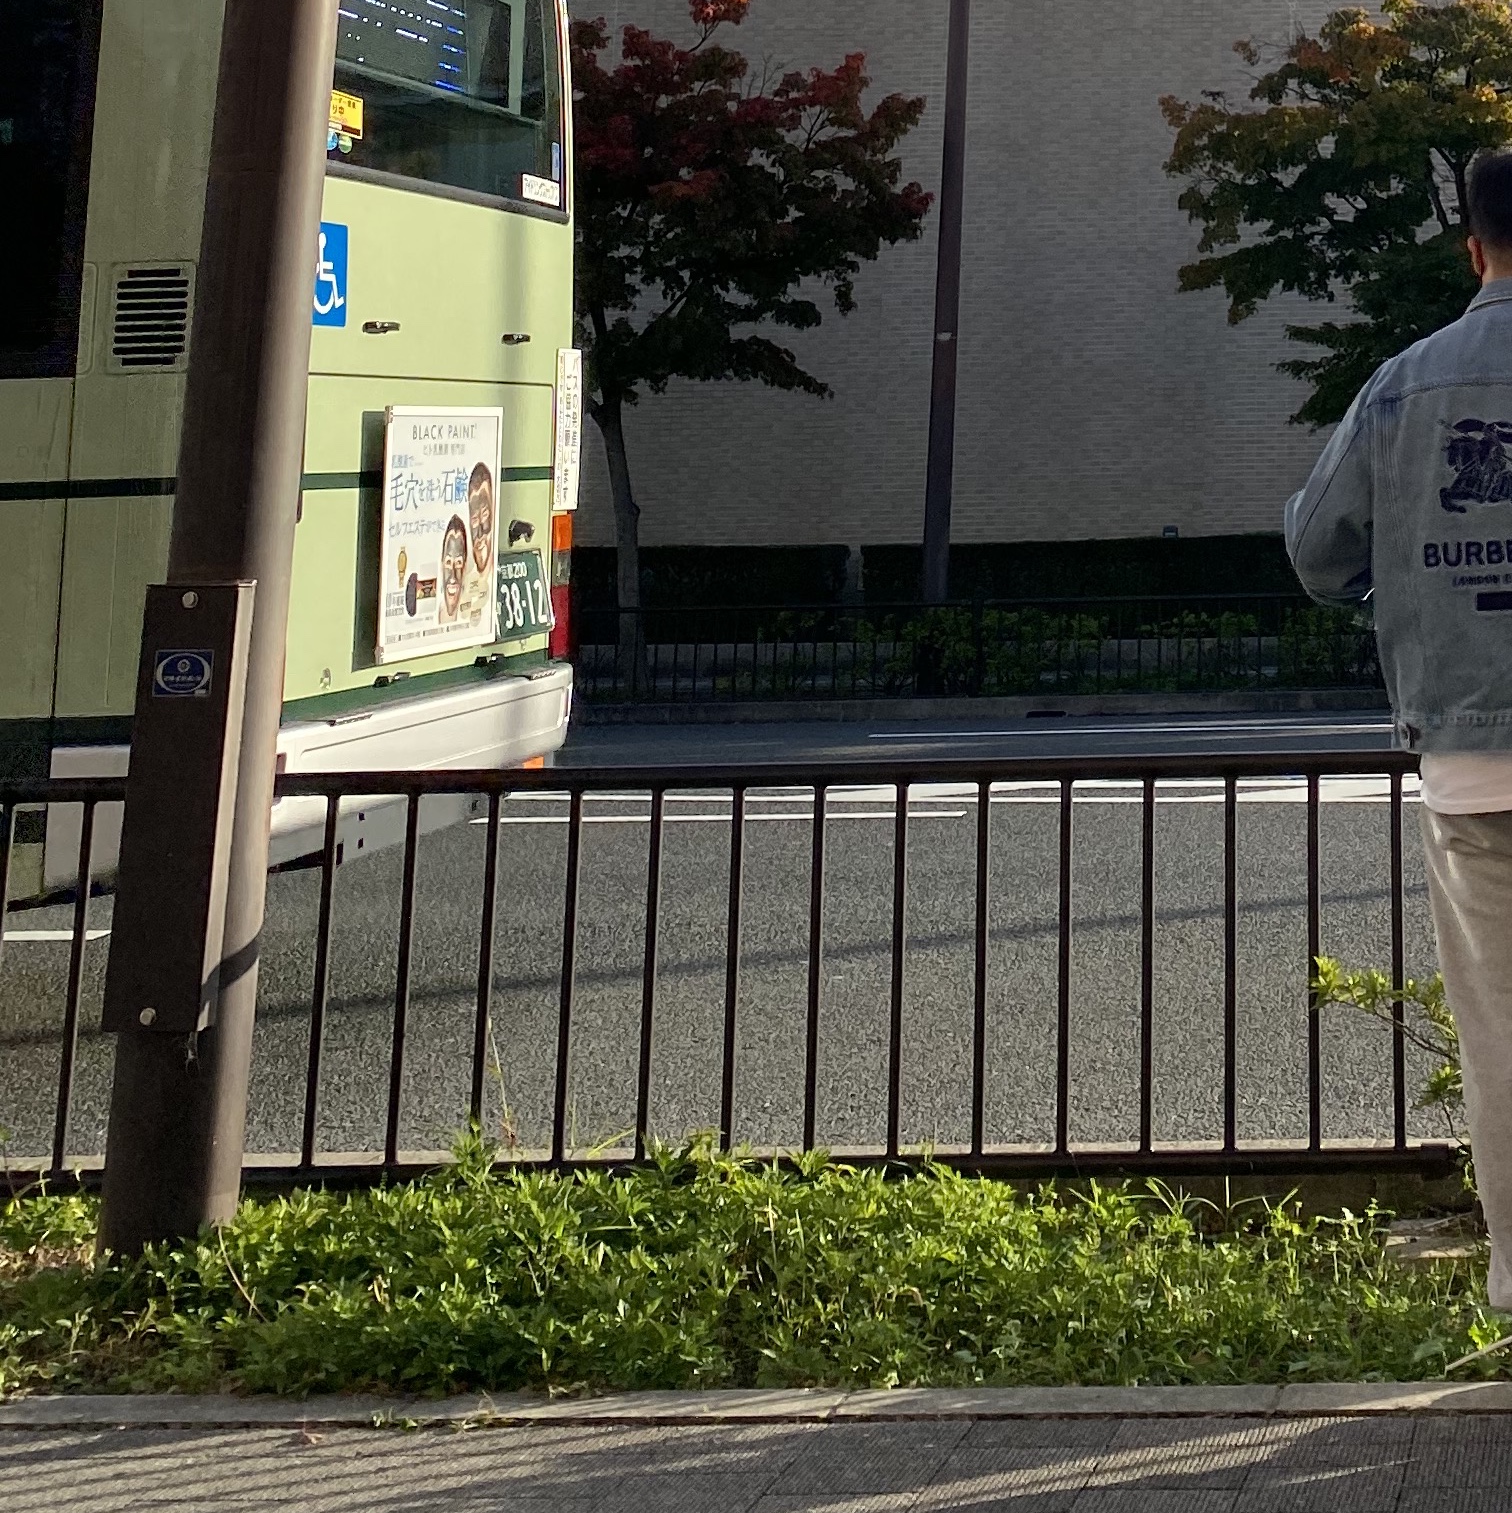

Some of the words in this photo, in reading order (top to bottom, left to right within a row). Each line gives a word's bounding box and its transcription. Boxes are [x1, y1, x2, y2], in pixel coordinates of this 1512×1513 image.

[412, 424, 443, 440] BLACK
[447, 424, 475, 439] PAINT
[1452, 575, 1499, 587] LONDON
[501, 579, 547, 629] 38-12
